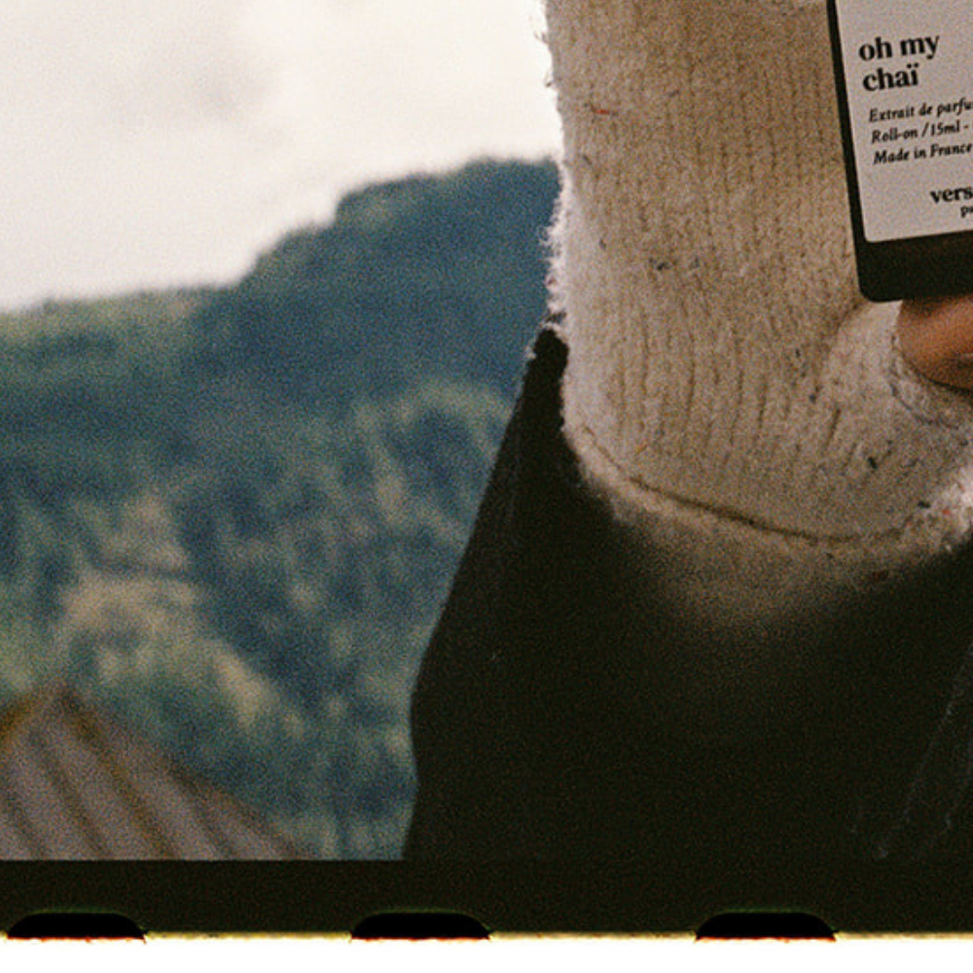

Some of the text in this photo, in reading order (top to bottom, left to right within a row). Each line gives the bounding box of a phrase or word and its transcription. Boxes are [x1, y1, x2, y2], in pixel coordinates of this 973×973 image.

[858, 35, 940, 61] oh my
[862, 63, 919, 91] chaï
[869, 105, 915, 123] Extrait
[918, 103, 933, 116] de
[872, 127, 918, 144] Roll-on
[873, 141, 973, 165] Made in France
